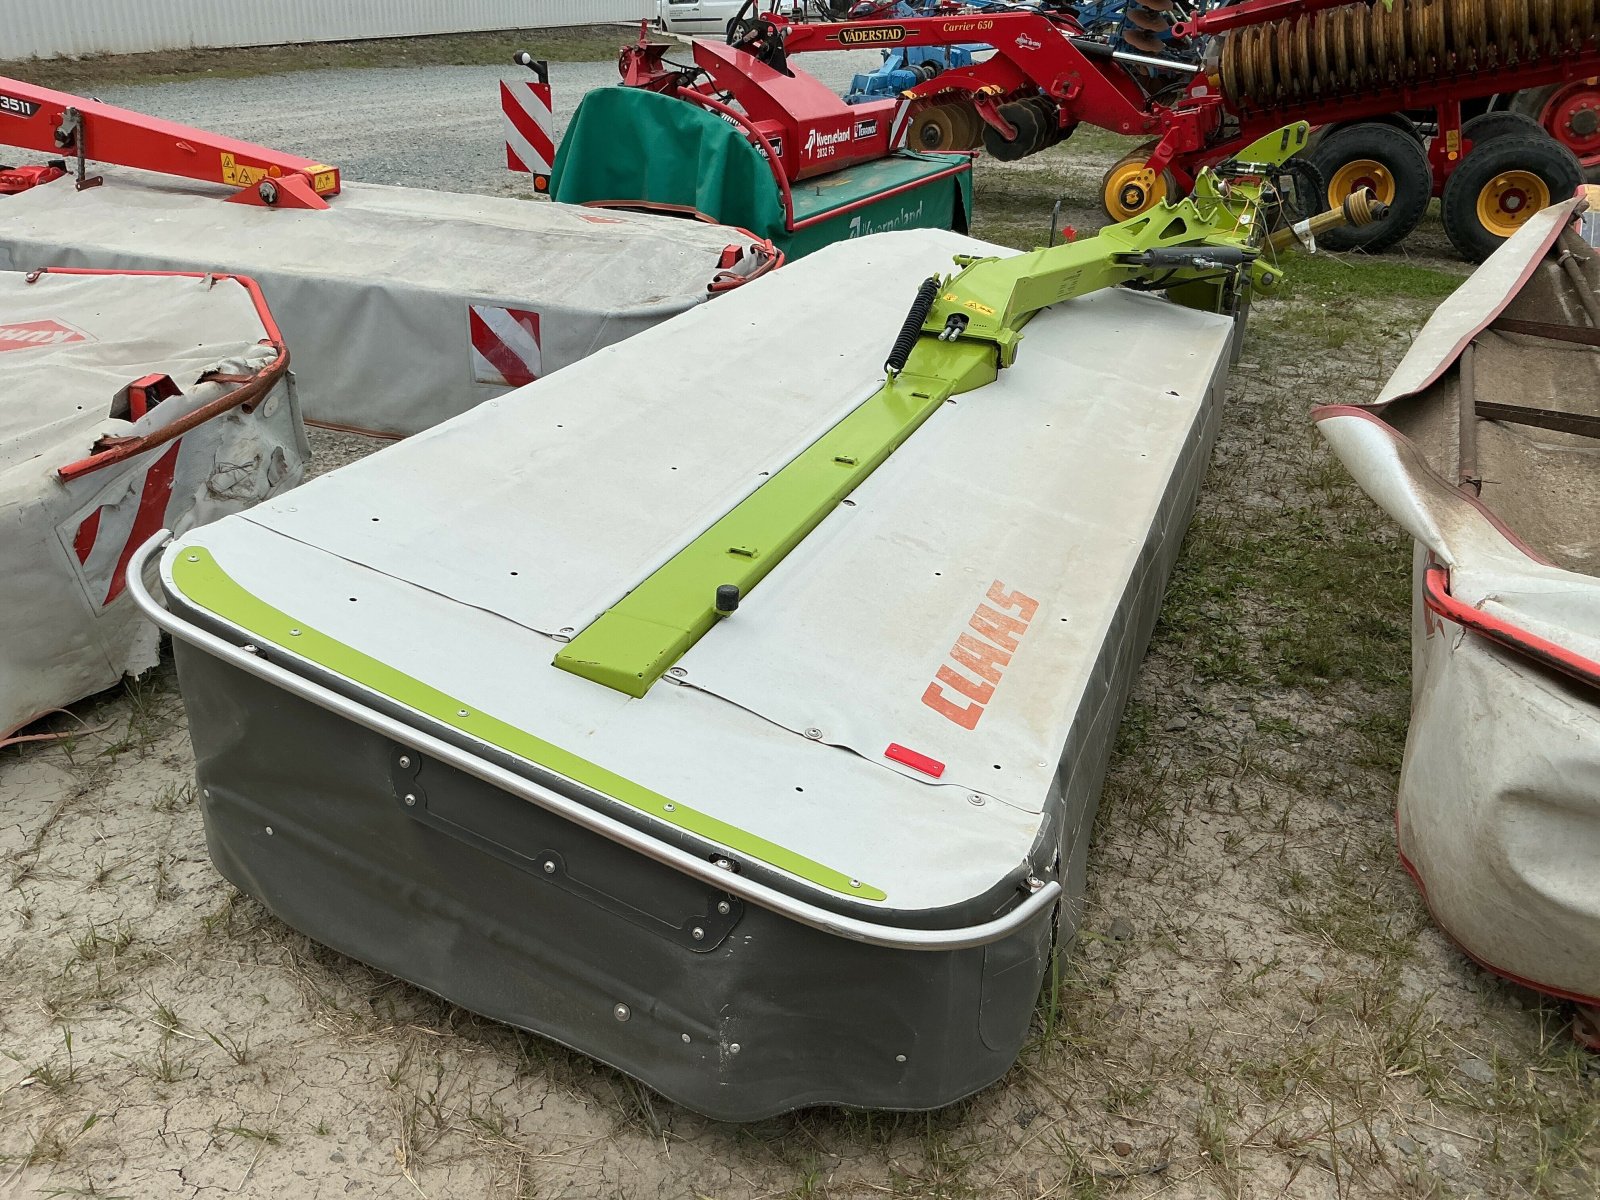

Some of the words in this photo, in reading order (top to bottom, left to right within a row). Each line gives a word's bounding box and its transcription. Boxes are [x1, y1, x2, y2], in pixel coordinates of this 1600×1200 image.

[843, 27, 901, 42] VÄDERSTAD
[943, 22, 975, 32] Carrier
[977, 20, 994, 30] 650
[0, 96, 31, 115] 3511
[816, 127, 851, 147] Kverneland
[921, 578, 1040, 731] CLAAS
